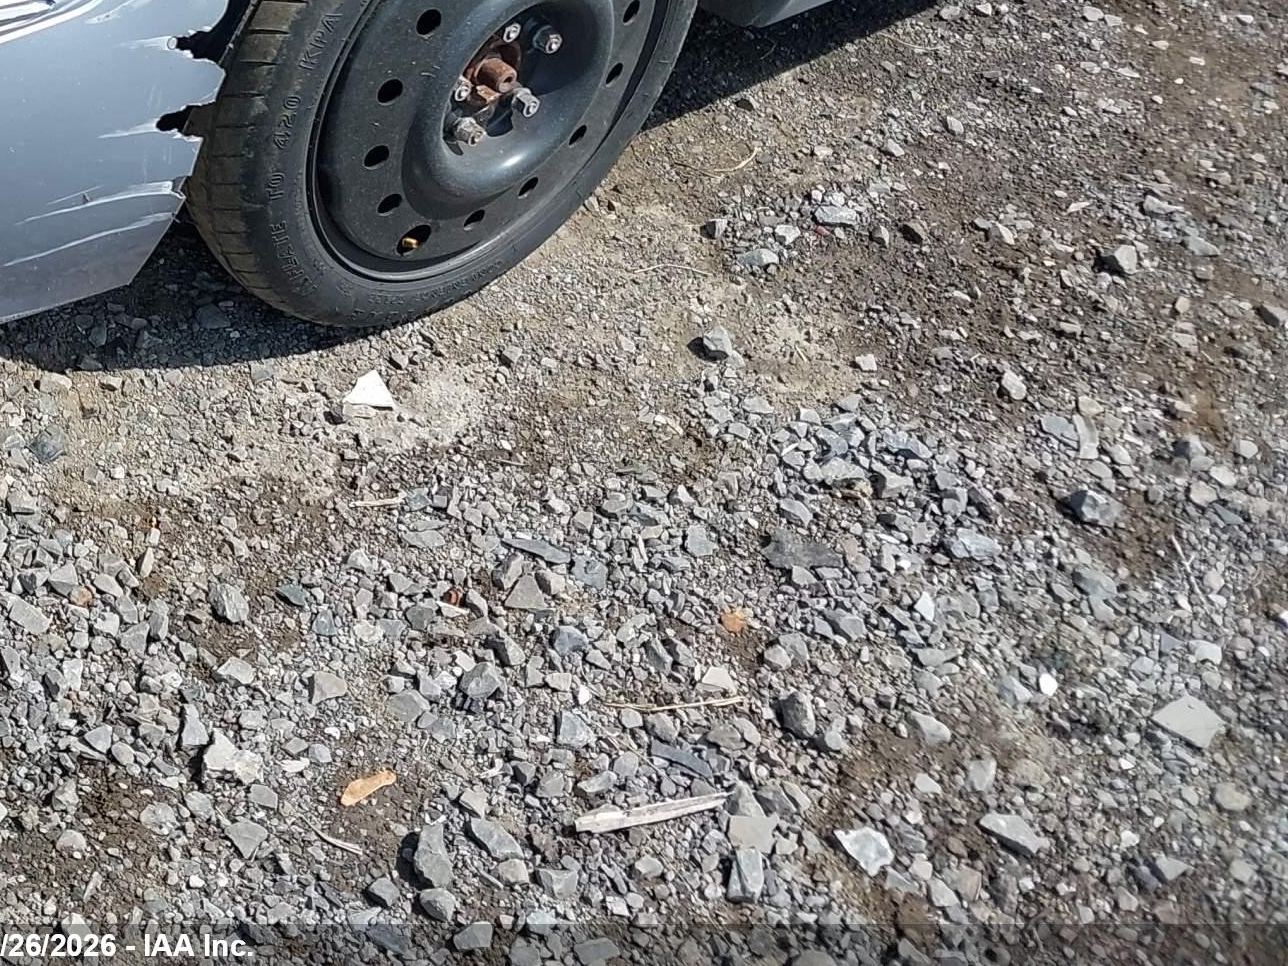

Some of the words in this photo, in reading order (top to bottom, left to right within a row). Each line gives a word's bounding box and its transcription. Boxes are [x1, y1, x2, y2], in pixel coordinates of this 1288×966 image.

[298, 13, 343, 70] KPA
[271, 94, 301, 150] 420
[264, 172, 285, 202] TO
